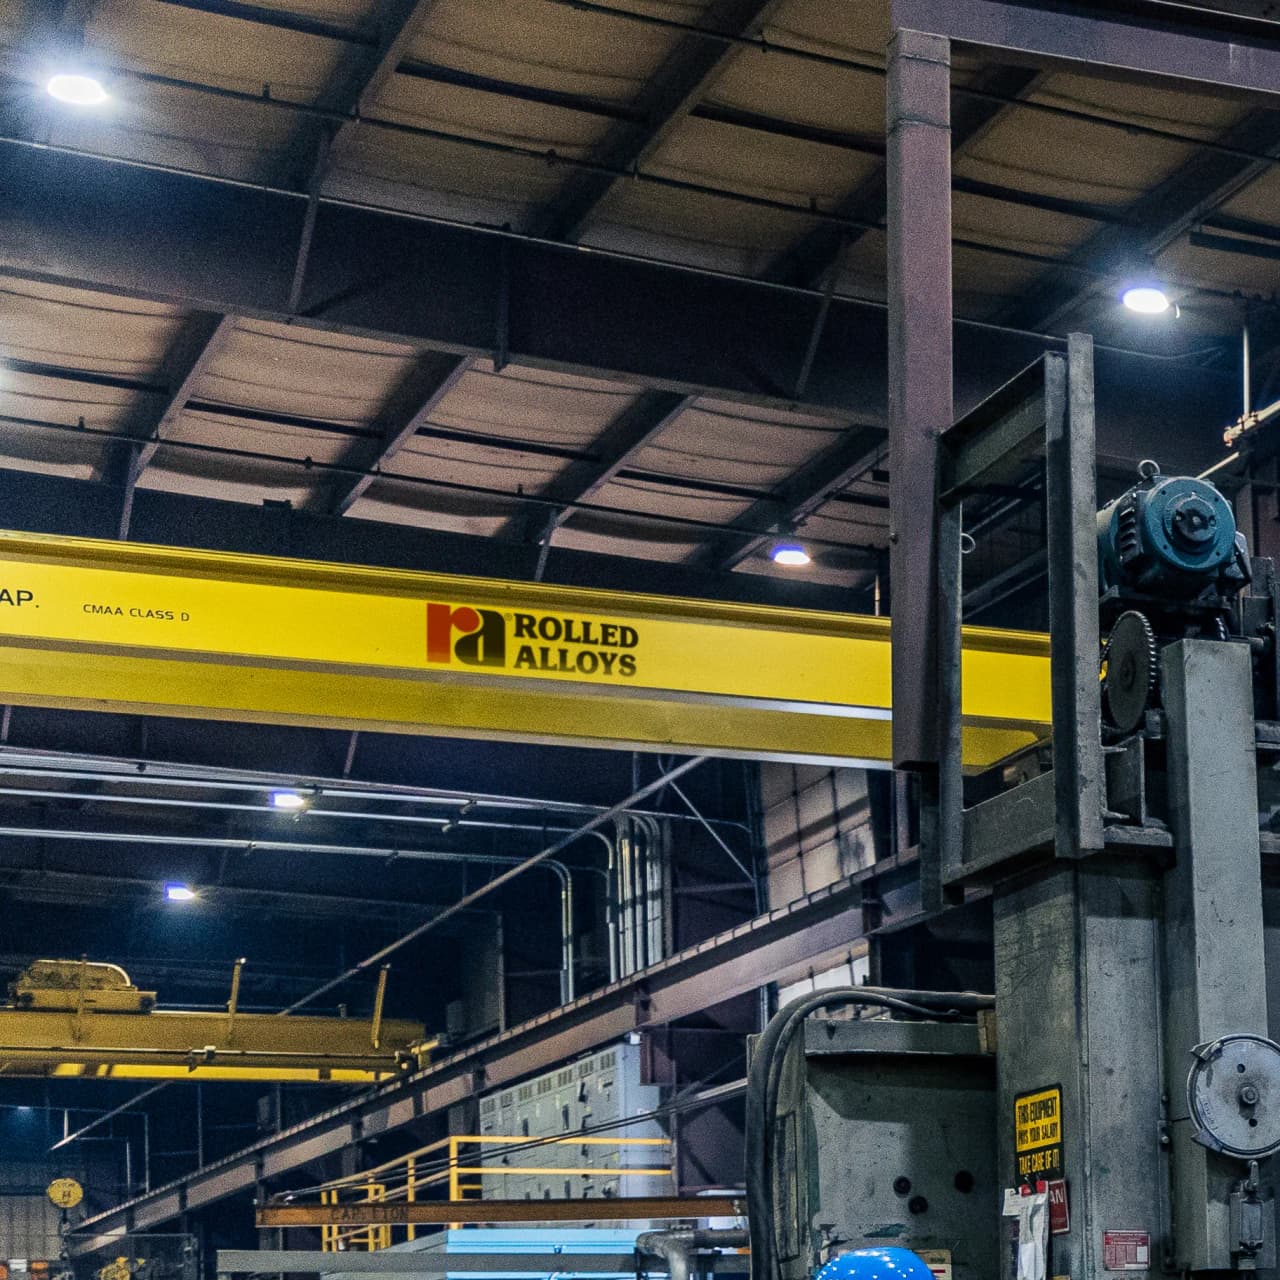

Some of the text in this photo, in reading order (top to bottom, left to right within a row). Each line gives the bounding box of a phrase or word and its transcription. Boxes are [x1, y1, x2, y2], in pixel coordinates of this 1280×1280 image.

[83, 603, 190, 622] CMAA CLASS D
[514, 612, 639, 648] ROLLED
[514, 645, 637, 677] ALLOYS
[1018, 1096, 1058, 1125] THIS EQUIPMENT
[1018, 1121, 1059, 1146] PAYS YOUR SALARY
[1019, 1152, 1031, 1175] TAKE
[1032, 1150, 1044, 1173] CARE
[1045, 1149, 1052, 1170] OF
